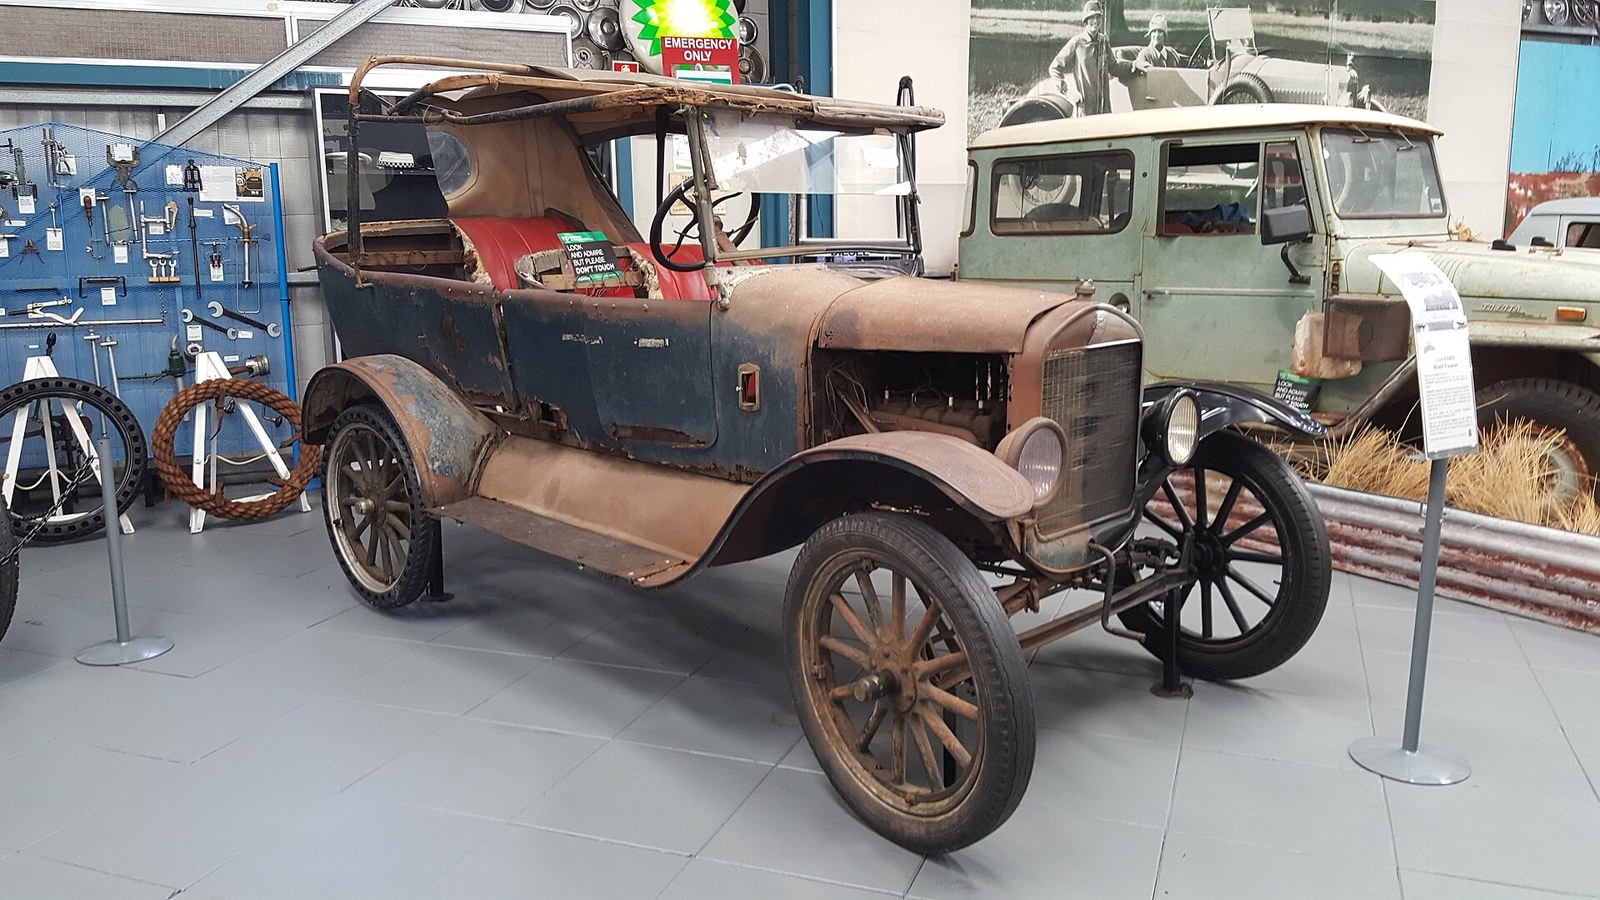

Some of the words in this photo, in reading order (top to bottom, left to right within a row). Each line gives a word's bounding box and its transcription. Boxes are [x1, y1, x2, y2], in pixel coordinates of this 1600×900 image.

[664, 37, 733, 50] EMERGENCY
[683, 50, 712, 62] ONLY
[570, 251, 583, 259] AND
[583, 249, 605, 257] ADMIRE
[573, 259, 585, 267] BUT
[585, 256, 606, 265] PLEASE
[576, 265, 594, 274] DON'T
[594, 263, 615, 272] TOUCH
[1277, 380, 1293, 388] LOOK
[1276, 386, 1288, 394] AND
[1274, 392, 1286, 400] BUT
[1290, 401, 1310, 409] TOUCH
